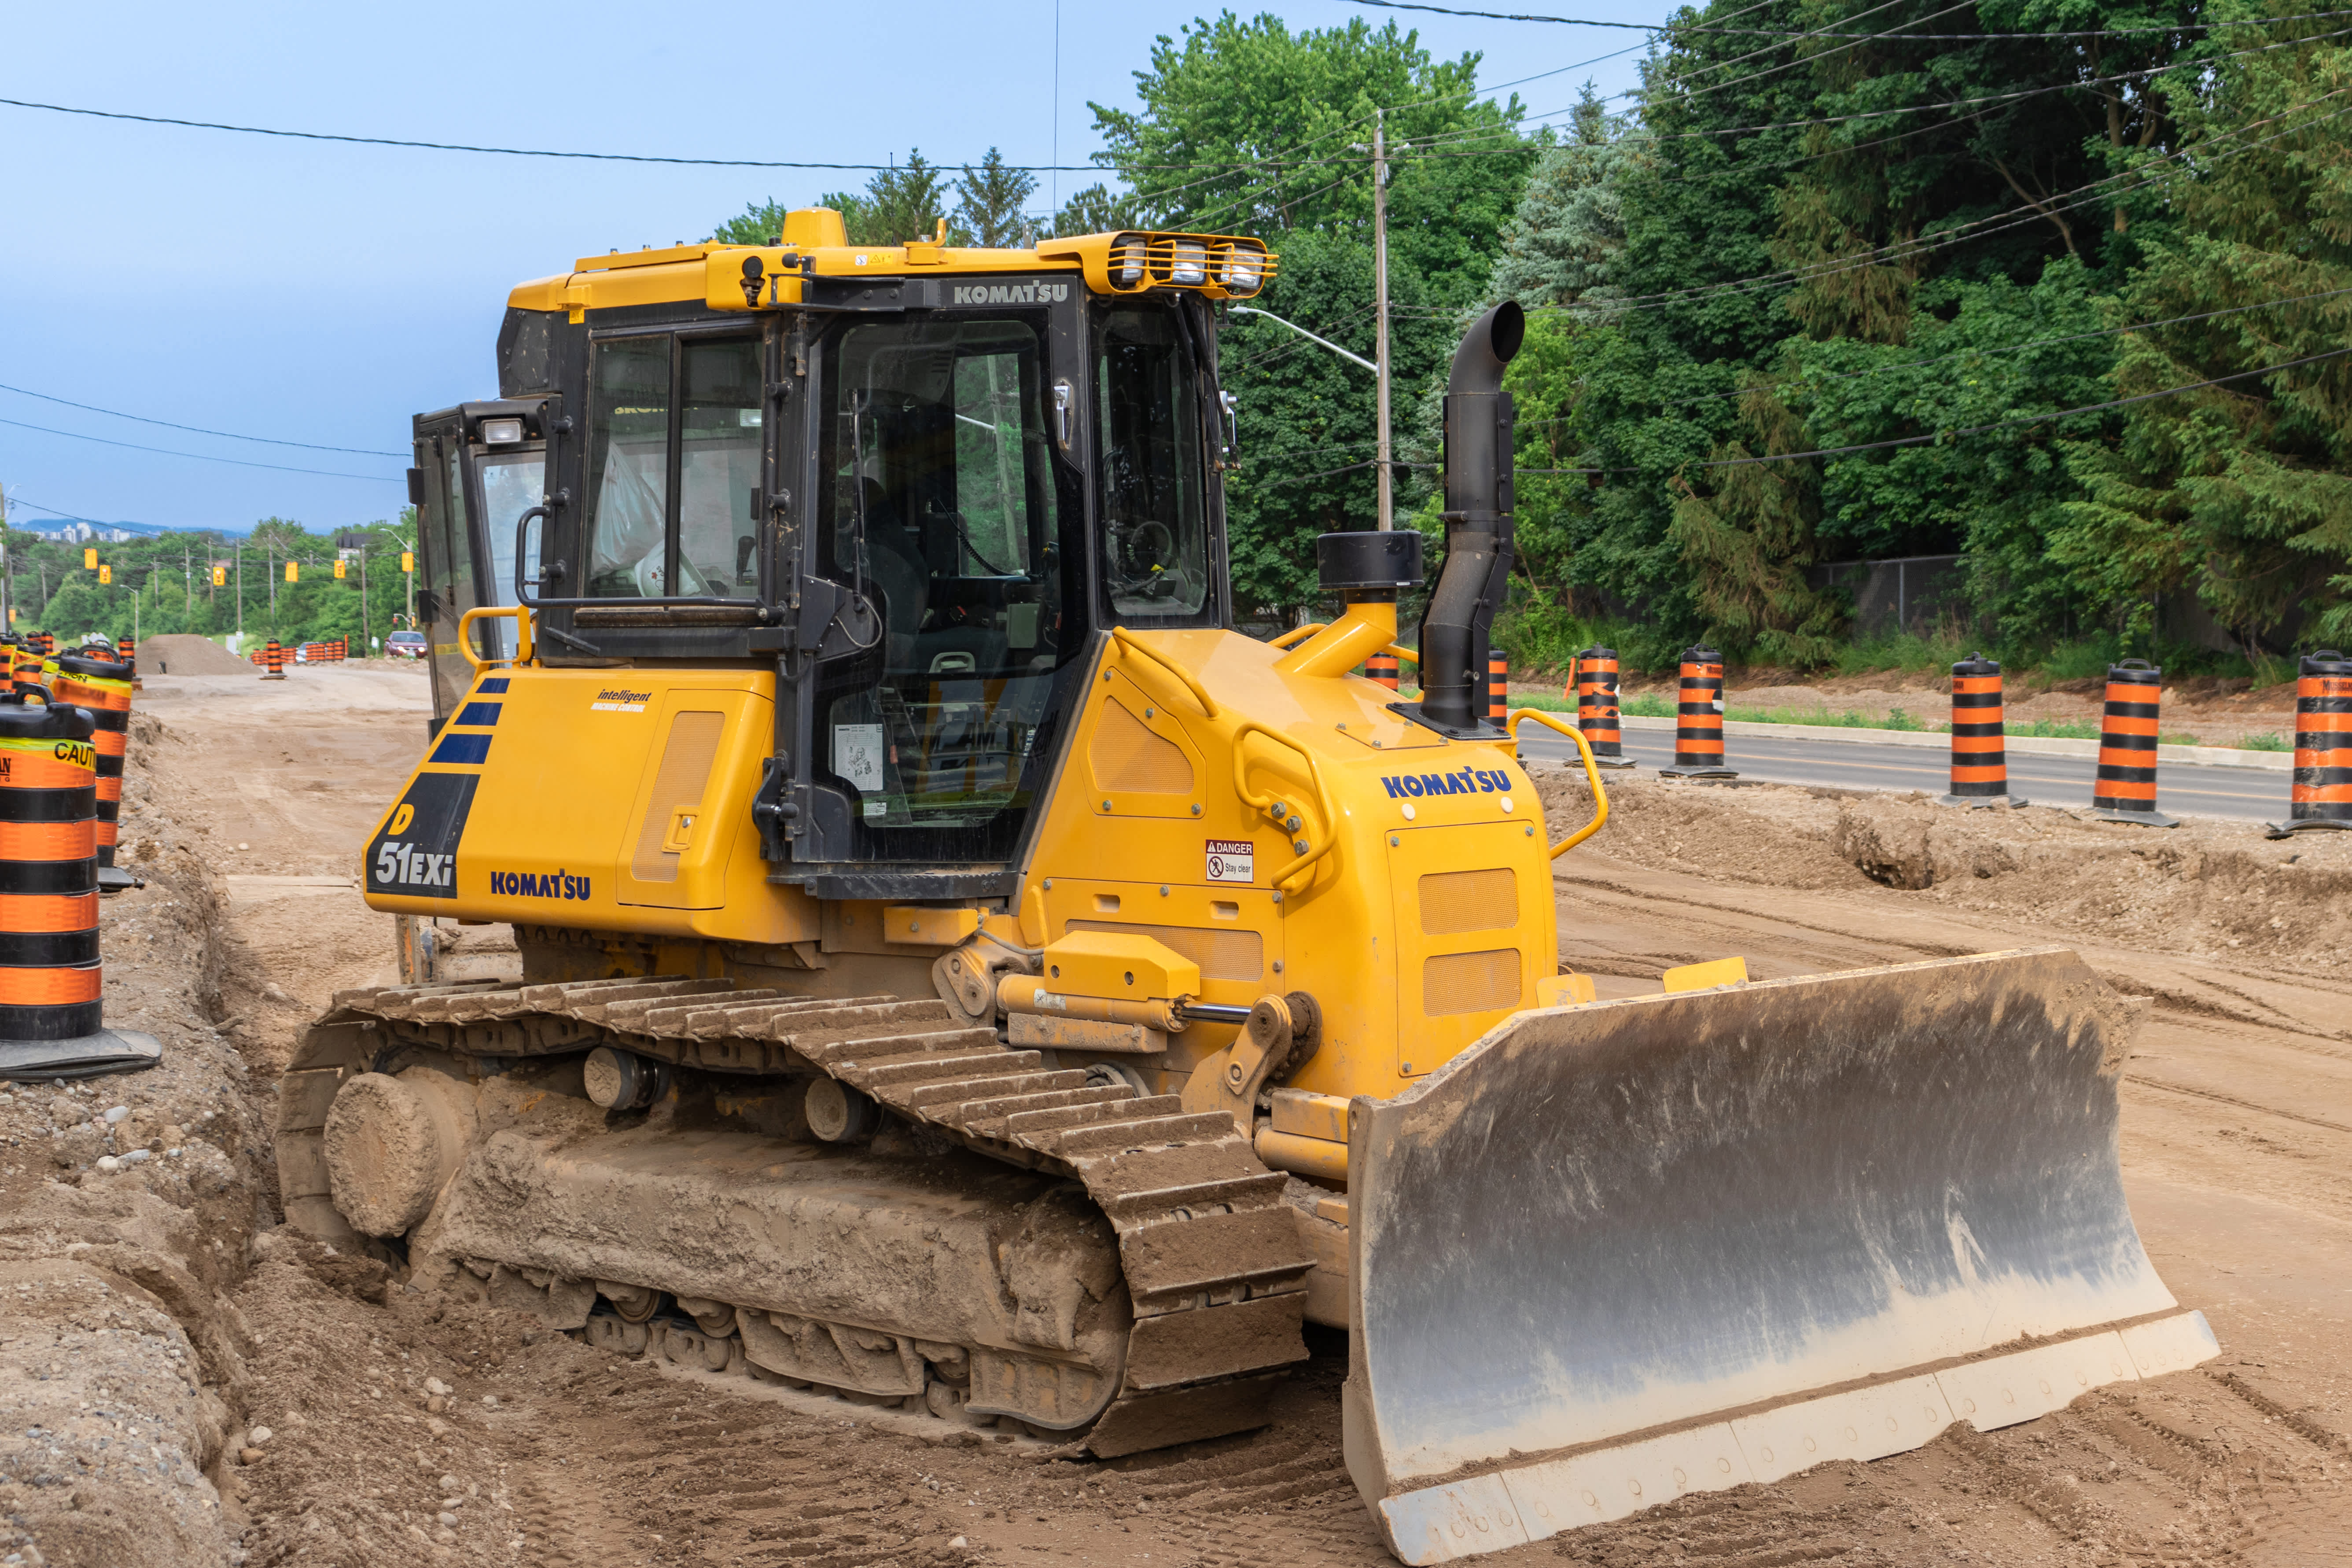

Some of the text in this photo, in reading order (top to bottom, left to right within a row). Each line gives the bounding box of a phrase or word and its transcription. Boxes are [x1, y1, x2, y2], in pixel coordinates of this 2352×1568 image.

[954, 280, 1067, 304] KOMATSU
[597, 689, 651, 703] intelligent
[591, 703, 645, 712] MACHINE CONTROL
[1380, 766, 1512, 798] KOMATSU
[387, 803, 415, 836] D
[1217, 843, 1252, 854] DANGER
[1226, 863, 1251, 874] Stay clear
[491, 868, 590, 901] KOMATSU
